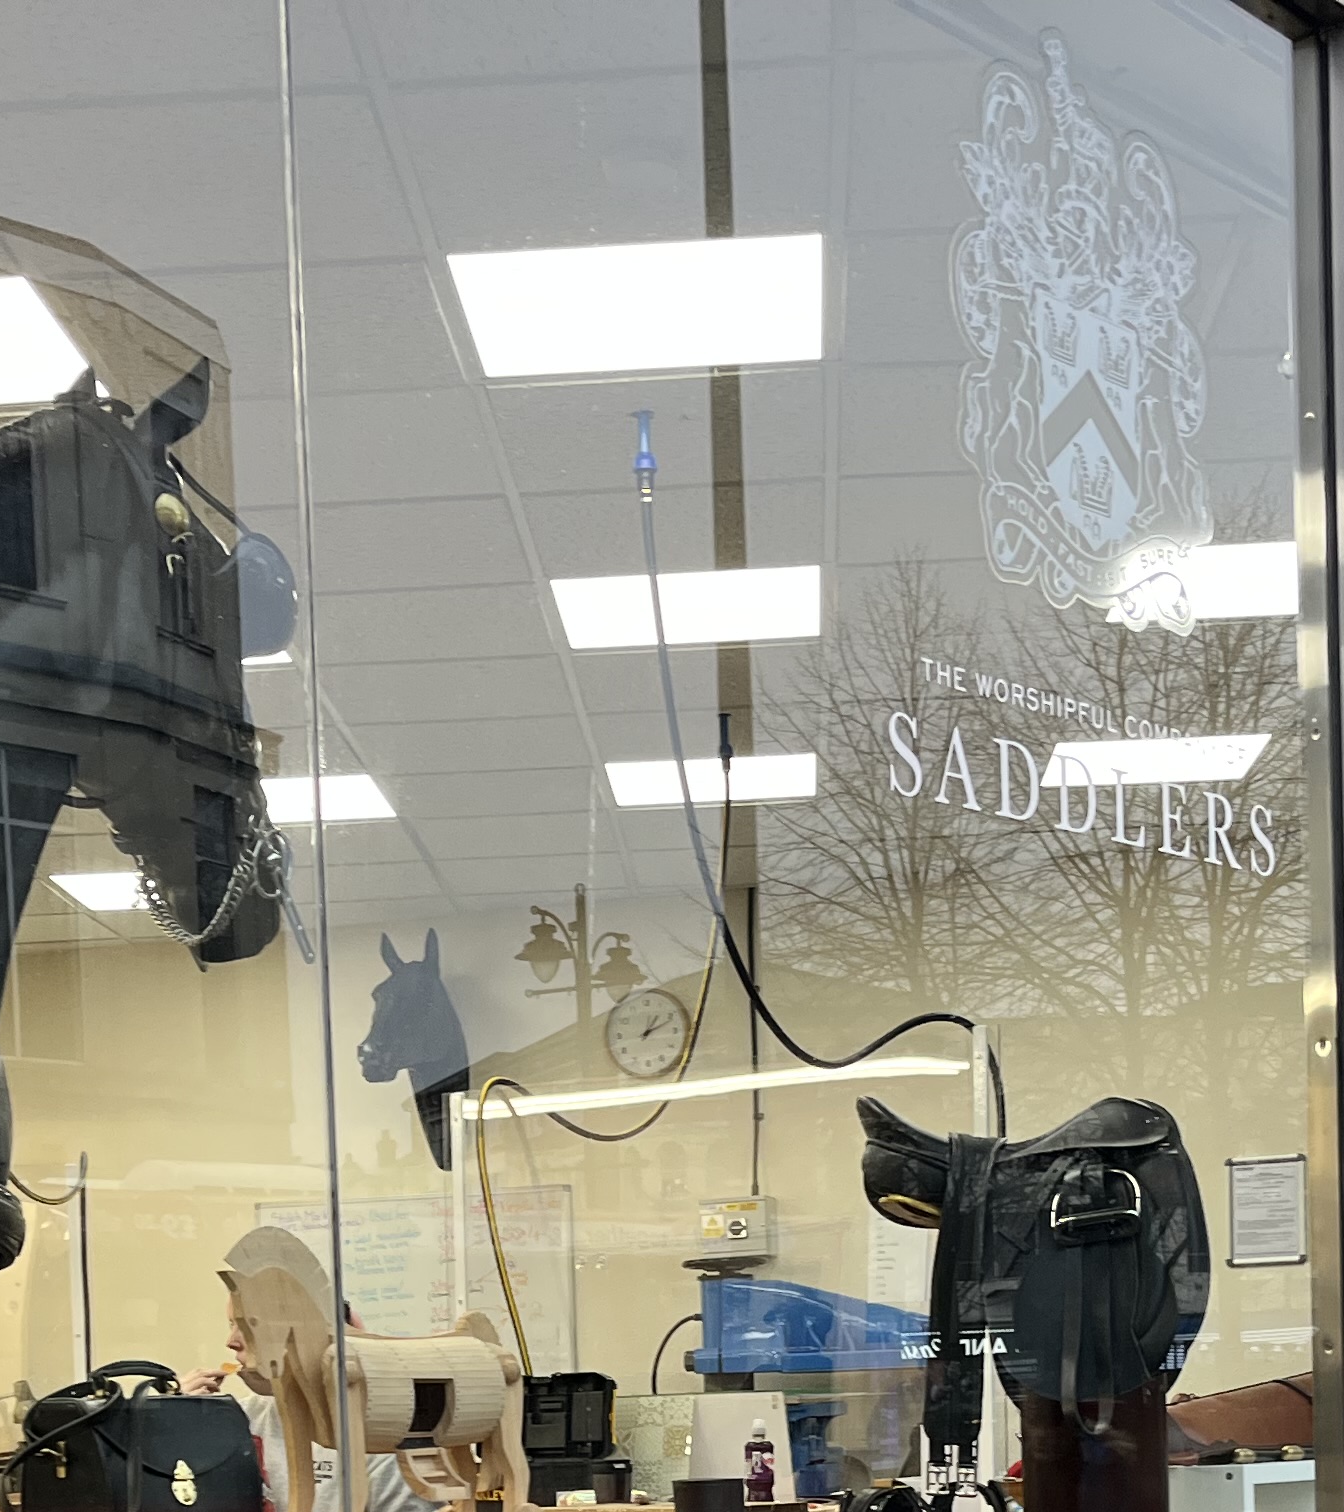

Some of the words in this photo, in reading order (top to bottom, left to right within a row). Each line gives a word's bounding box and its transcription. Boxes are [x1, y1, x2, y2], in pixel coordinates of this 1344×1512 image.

[1006, 494, 1048, 534] HOLD
[920, 657, 967, 694] THE
[974, 672, 1118, 734] WORSHIPFUL
[887, 710, 1277, 878] SADDLERS
